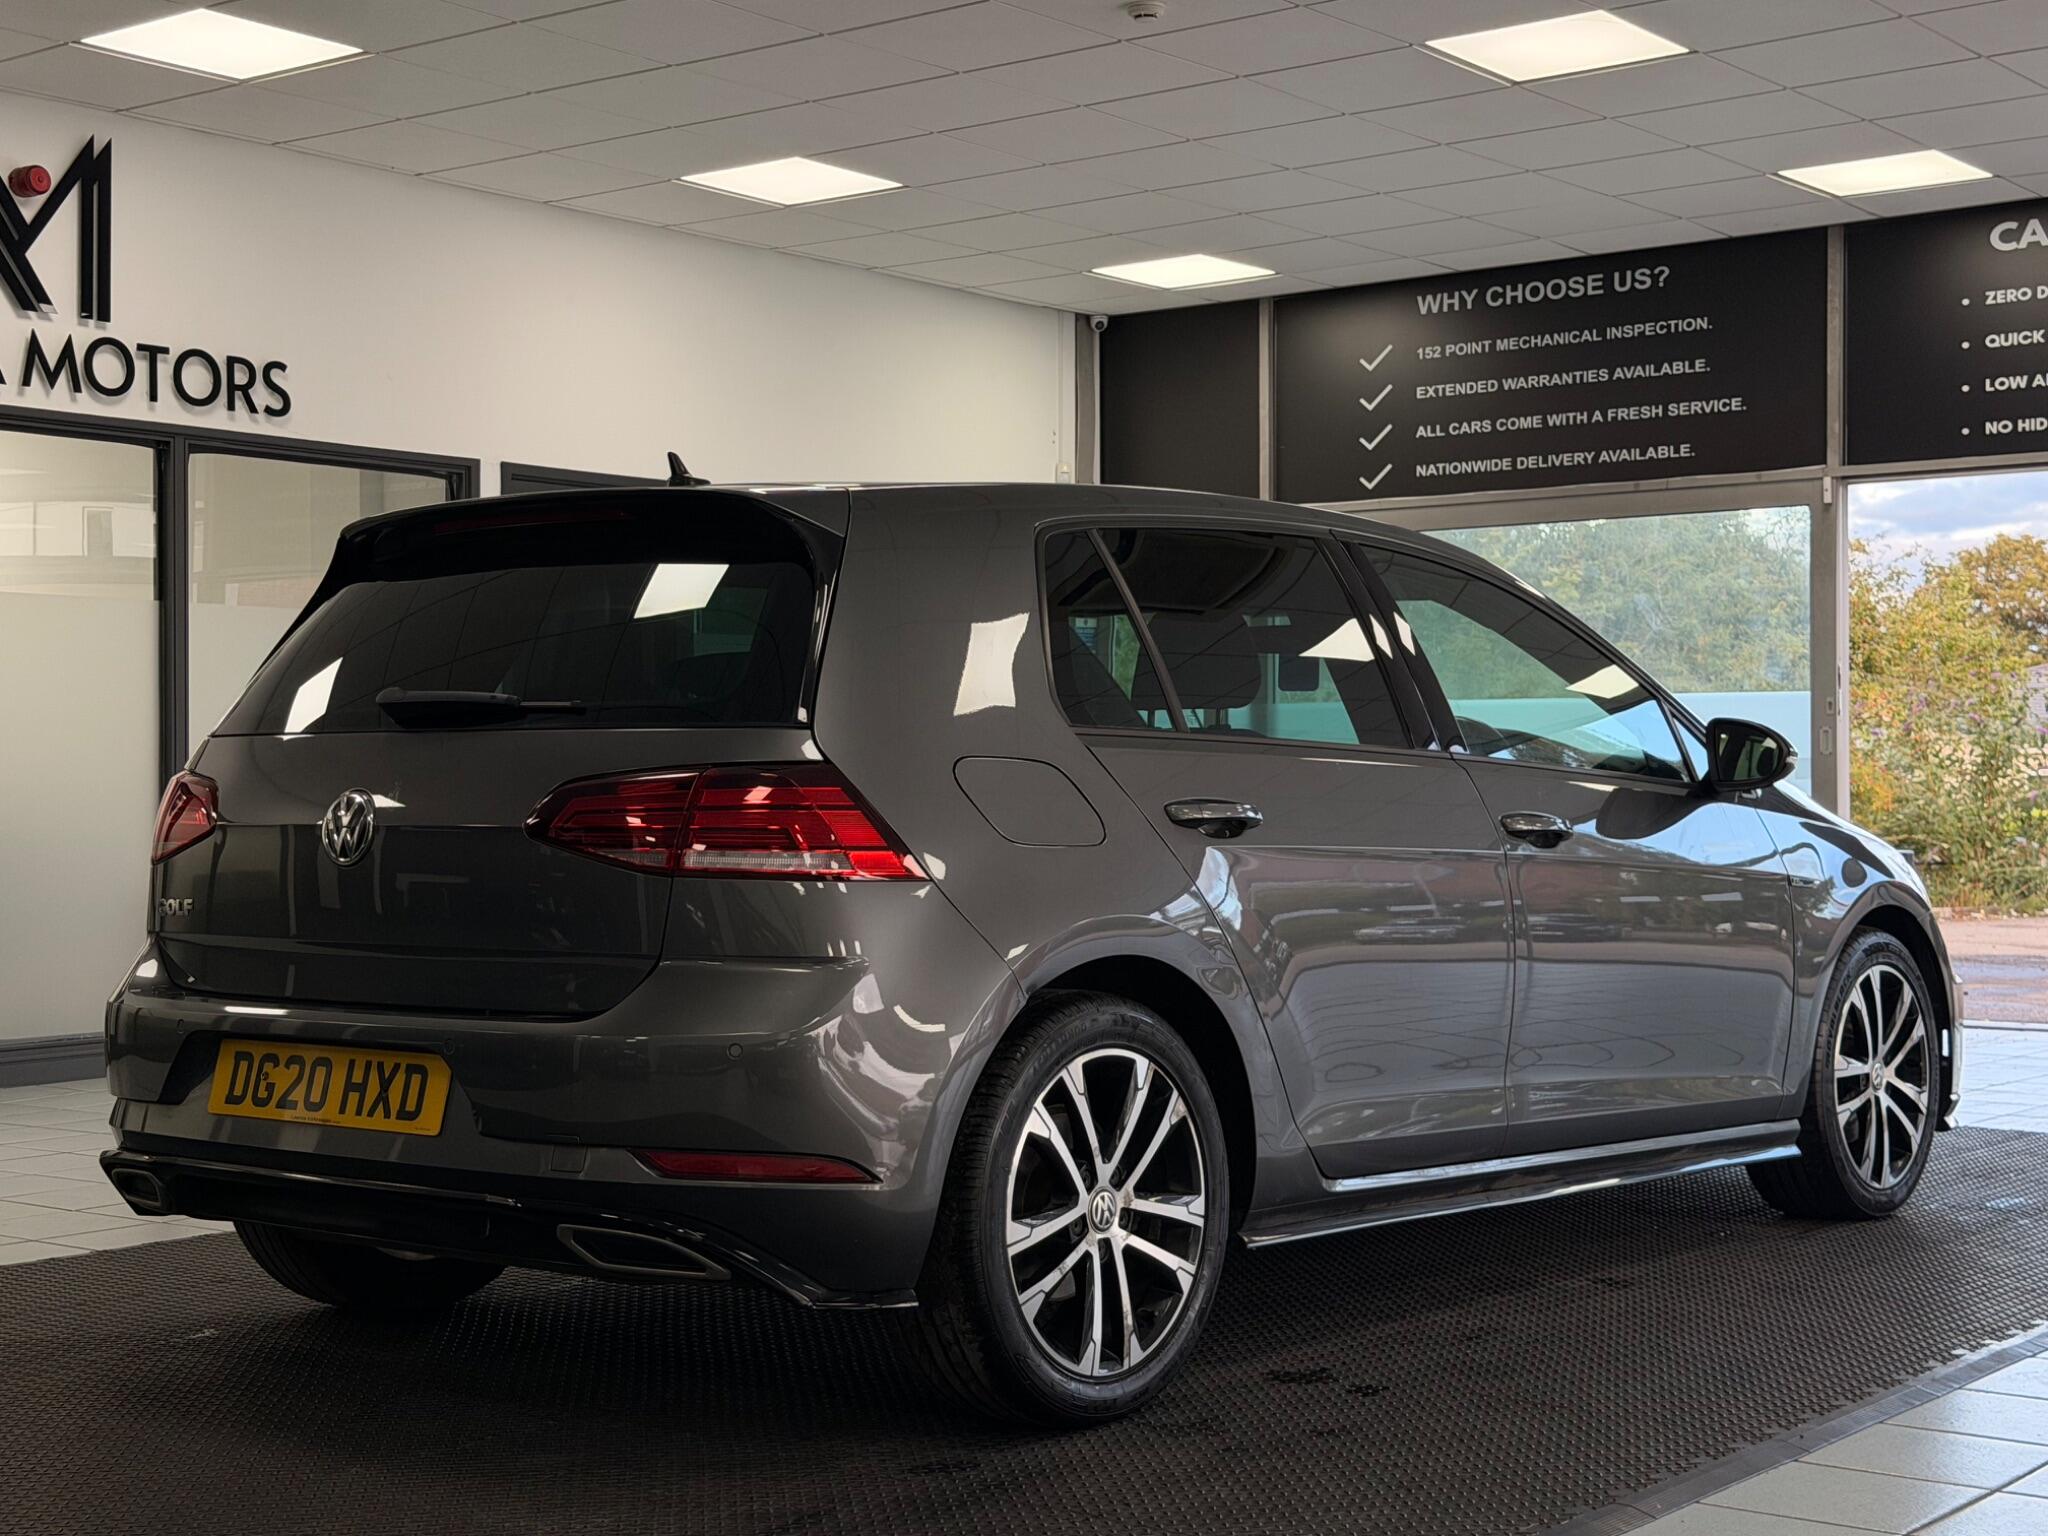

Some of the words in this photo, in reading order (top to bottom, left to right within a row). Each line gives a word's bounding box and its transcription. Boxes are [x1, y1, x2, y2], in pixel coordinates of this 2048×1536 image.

[1417, 288, 1478, 315] WHY
[1486, 274, 1604, 307] CHOOSE
[1613, 266, 1670, 292] US?
[1985, 287, 2032, 305] ZERO
[1417, 346, 1442, 360] 152
[1446, 340, 1492, 357] POINT
[1496, 328, 1602, 352] MECHANICAL
[1606, 316, 1713, 340] INSPECTION.
[1985, 329, 2045, 348] QUICK
[22, 328, 292, 417] MOTORS
[1416, 379, 1498, 399] EXTENDED
[1502, 368, 1609, 391] WARRANTIES
[1612, 358, 1711, 380] AVAILABLE.
[1985, 375, 2028, 392] LOW
[1416, 424, 1445, 438] ALL
[1449, 420, 1492, 435] CARS
[1496, 415, 1543, 431] COME
[1546, 411, 1588, 427] WITH
[1591, 410, 1603, 423] A
[1607, 404, 1663, 421] FRESH
[1667, 397, 1747, 417] SERVICE.
[1985, 420, 2013, 435] NO
[1416, 457, 1513, 477] NATIONWIDE
[1516, 451, 1595, 470] DELIVERY
[1598, 444, 1695, 463] AVAILABLE.
[224, 1049, 333, 1112] DG20
[338, 1058, 429, 1123] HXD
